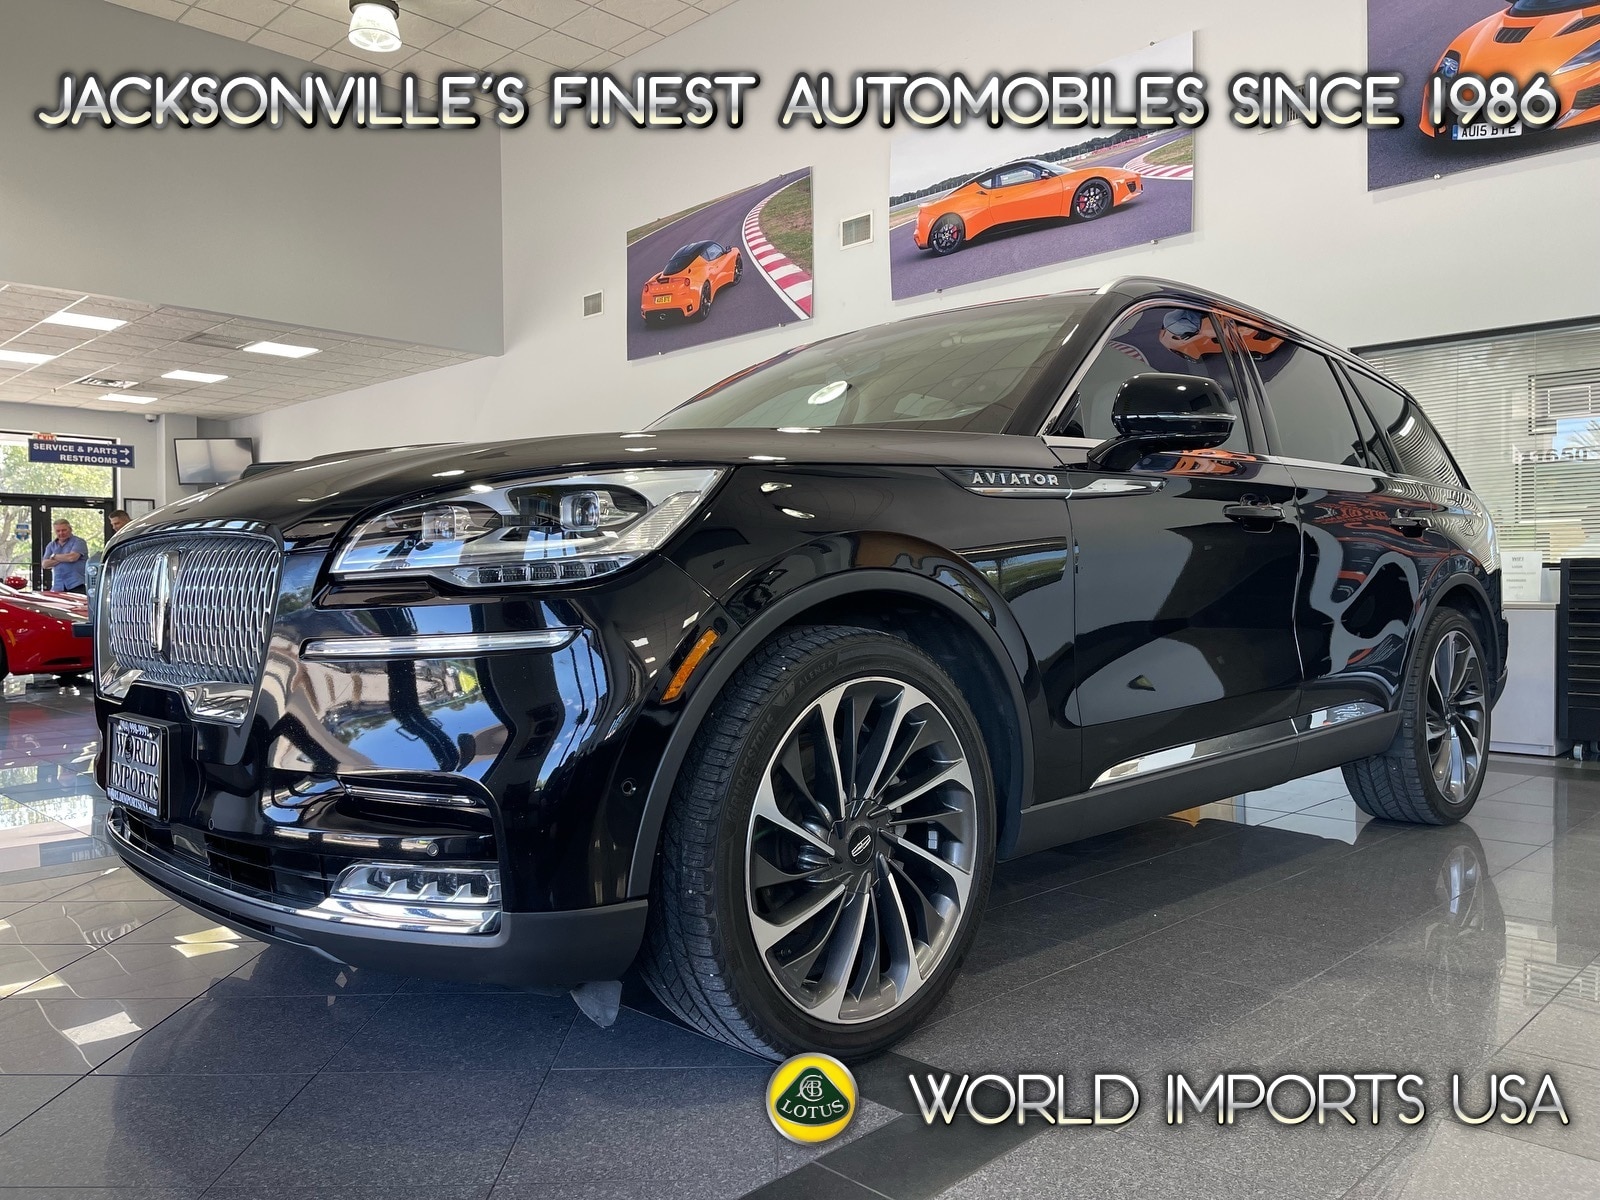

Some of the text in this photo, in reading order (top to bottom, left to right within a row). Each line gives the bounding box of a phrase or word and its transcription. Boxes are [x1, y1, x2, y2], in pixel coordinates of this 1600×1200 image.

[1461, 125, 1487, 137] AU15
[33, 443, 118, 455] SERVICE & PARTS
[59, 454, 118, 465] RESTROOMS
[972, 472, 1059, 486] AVIATOR
[116, 731, 159, 767] WORLD
[110, 760, 159, 802] IMPORTS
